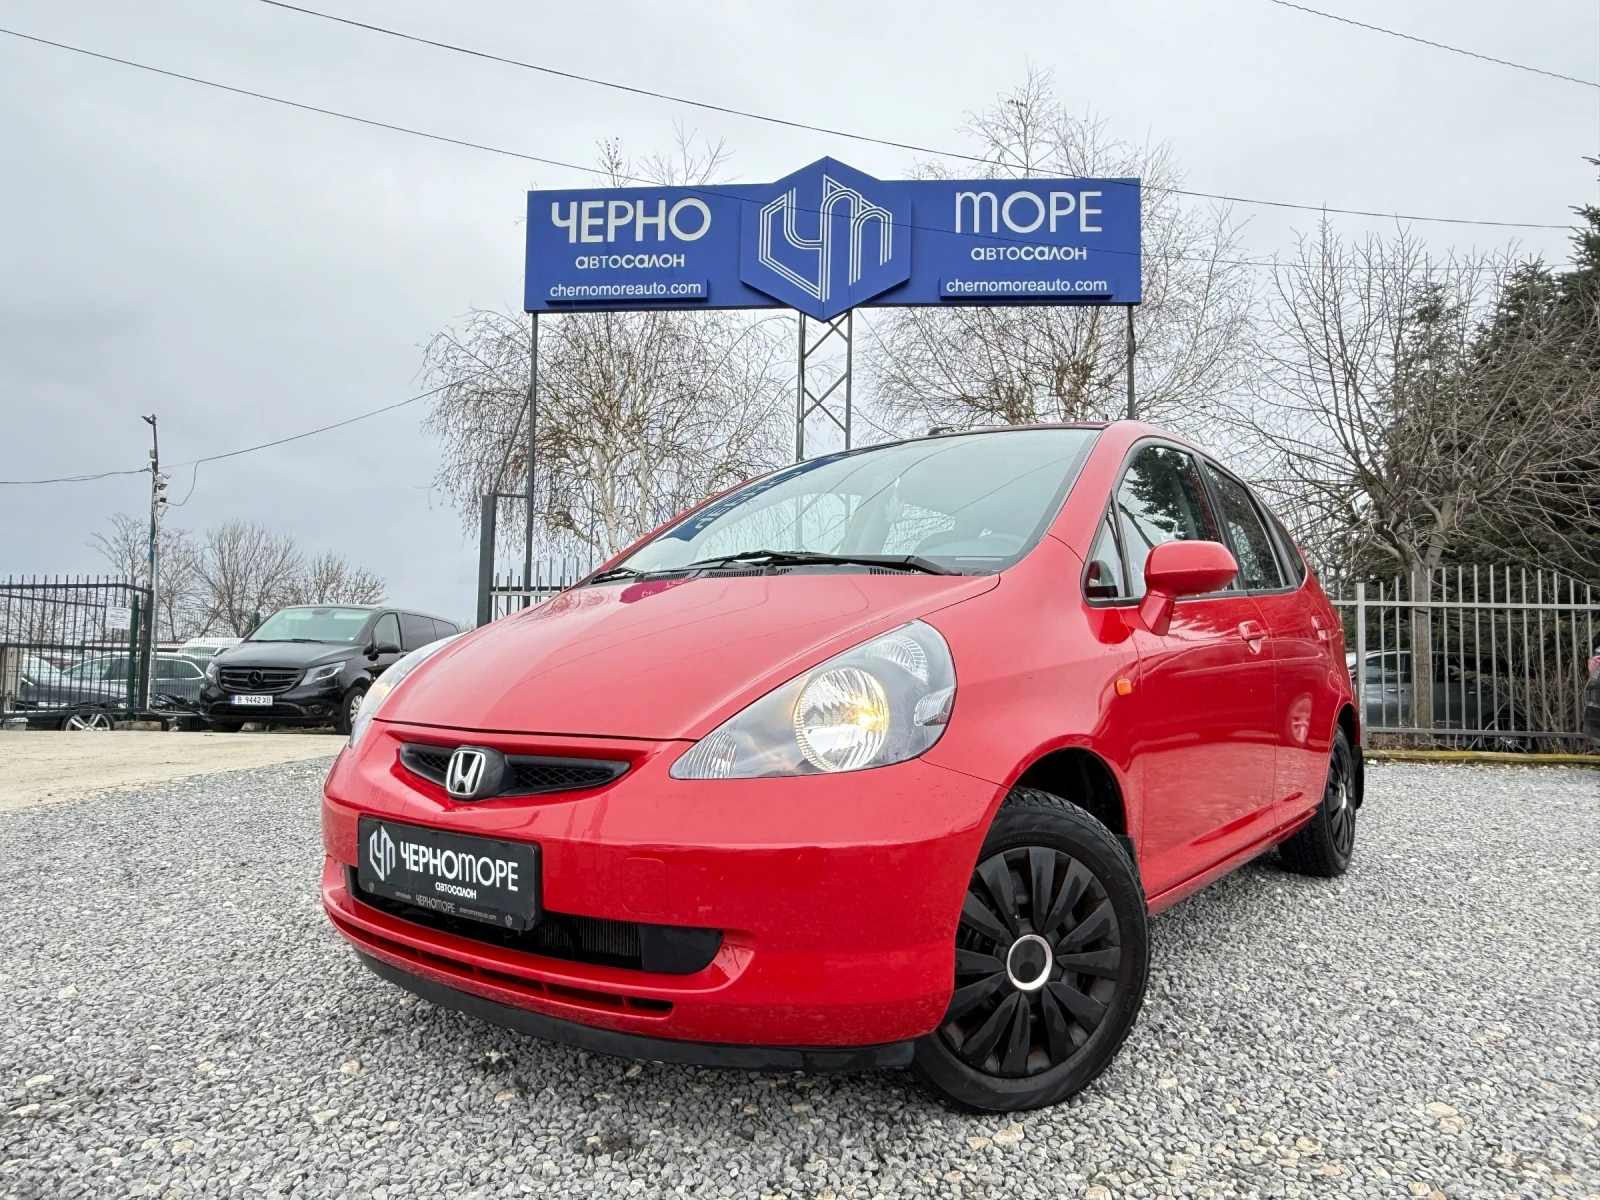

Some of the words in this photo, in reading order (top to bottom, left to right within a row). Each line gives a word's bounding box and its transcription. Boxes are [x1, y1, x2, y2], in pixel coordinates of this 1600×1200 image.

[551, 197, 712, 244] ЧЕРНО
[549, 281, 702, 297] chernomoreauto.com
[945, 277, 1108, 293] chernomoreauto.com
